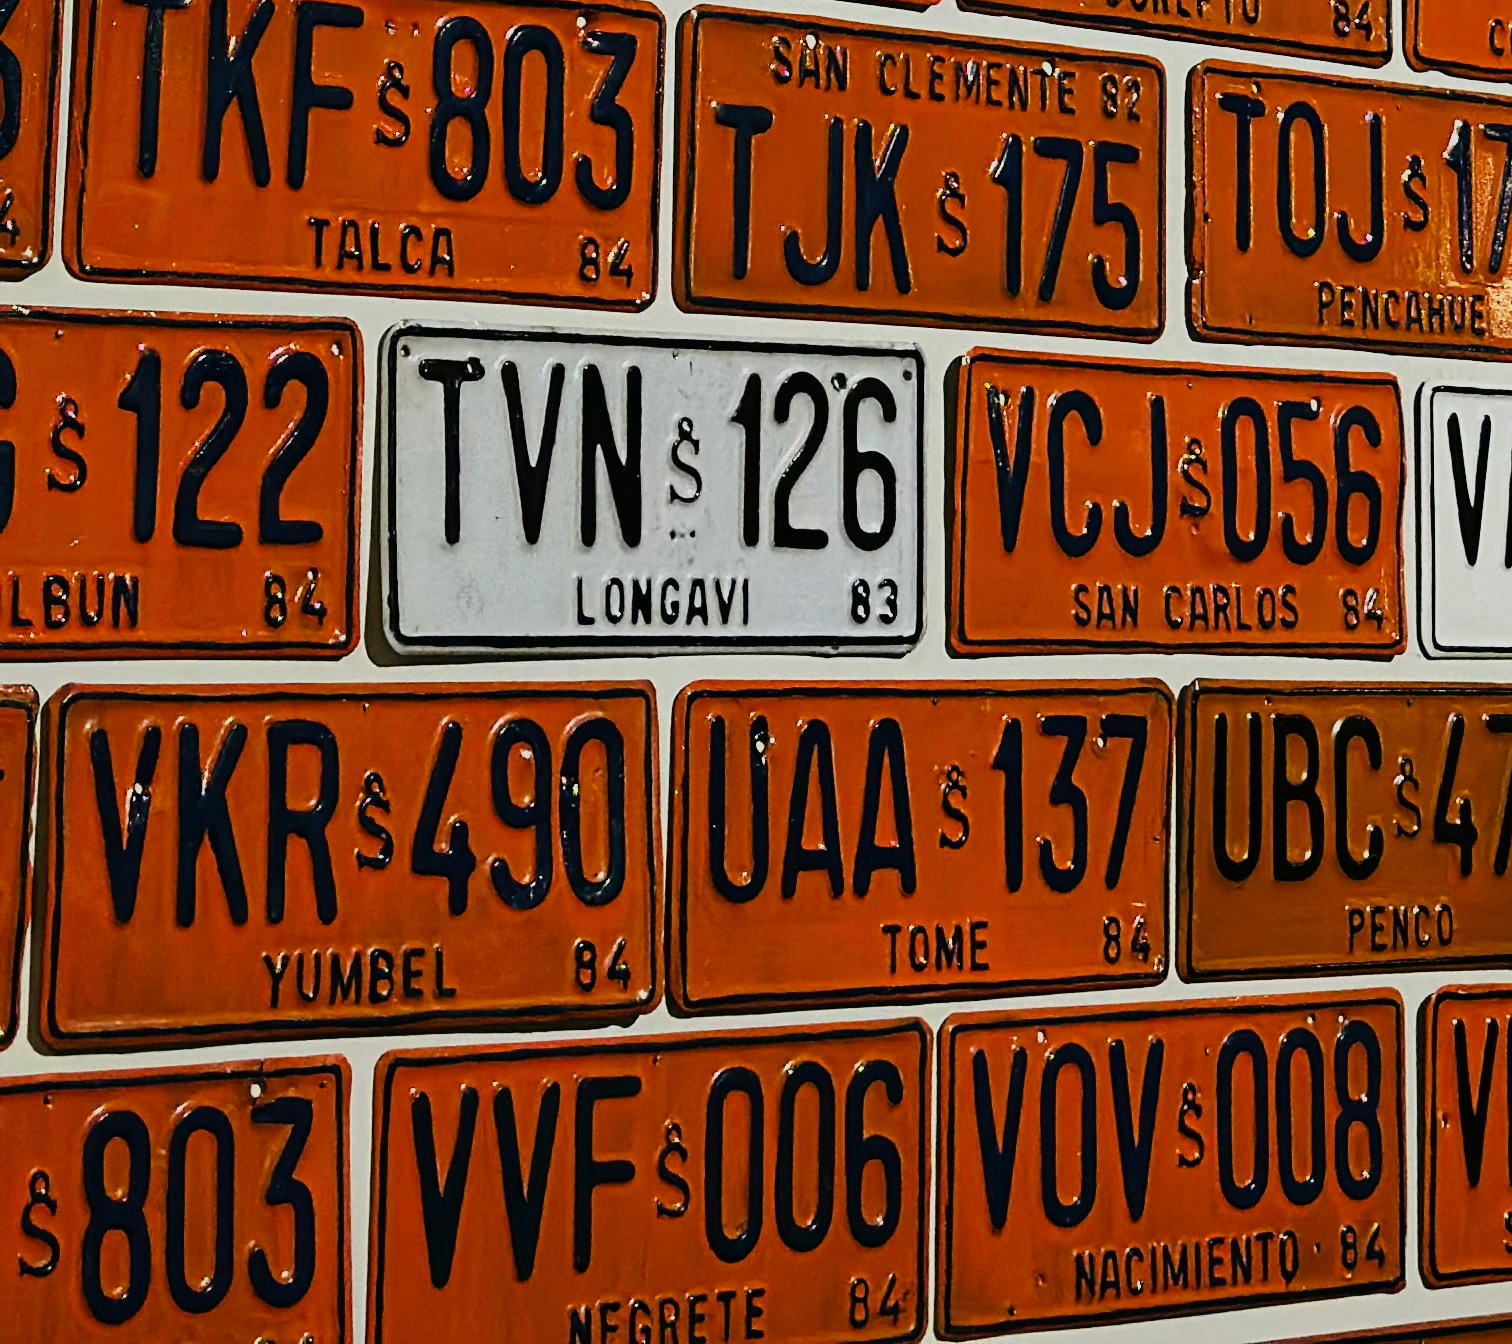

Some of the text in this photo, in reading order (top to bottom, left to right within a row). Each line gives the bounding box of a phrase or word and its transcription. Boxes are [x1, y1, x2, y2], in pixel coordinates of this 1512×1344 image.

[770, 34, 1076, 115] SAN CLEMENTE
[308, 217, 635, 287] TALCA 84
[1315, 280, 1487, 338] PENCAHUE
[576, 576, 899, 628] LONGAVI 83
[1072, 582, 1299, 629] SAN CARLOS
[880, 920, 991, 974] TOME
[1347, 903, 1454, 955] PENCO
[262, 945, 458, 1009] YUMBEL
[1073, 1228, 1299, 1302] NACIMIENTO
